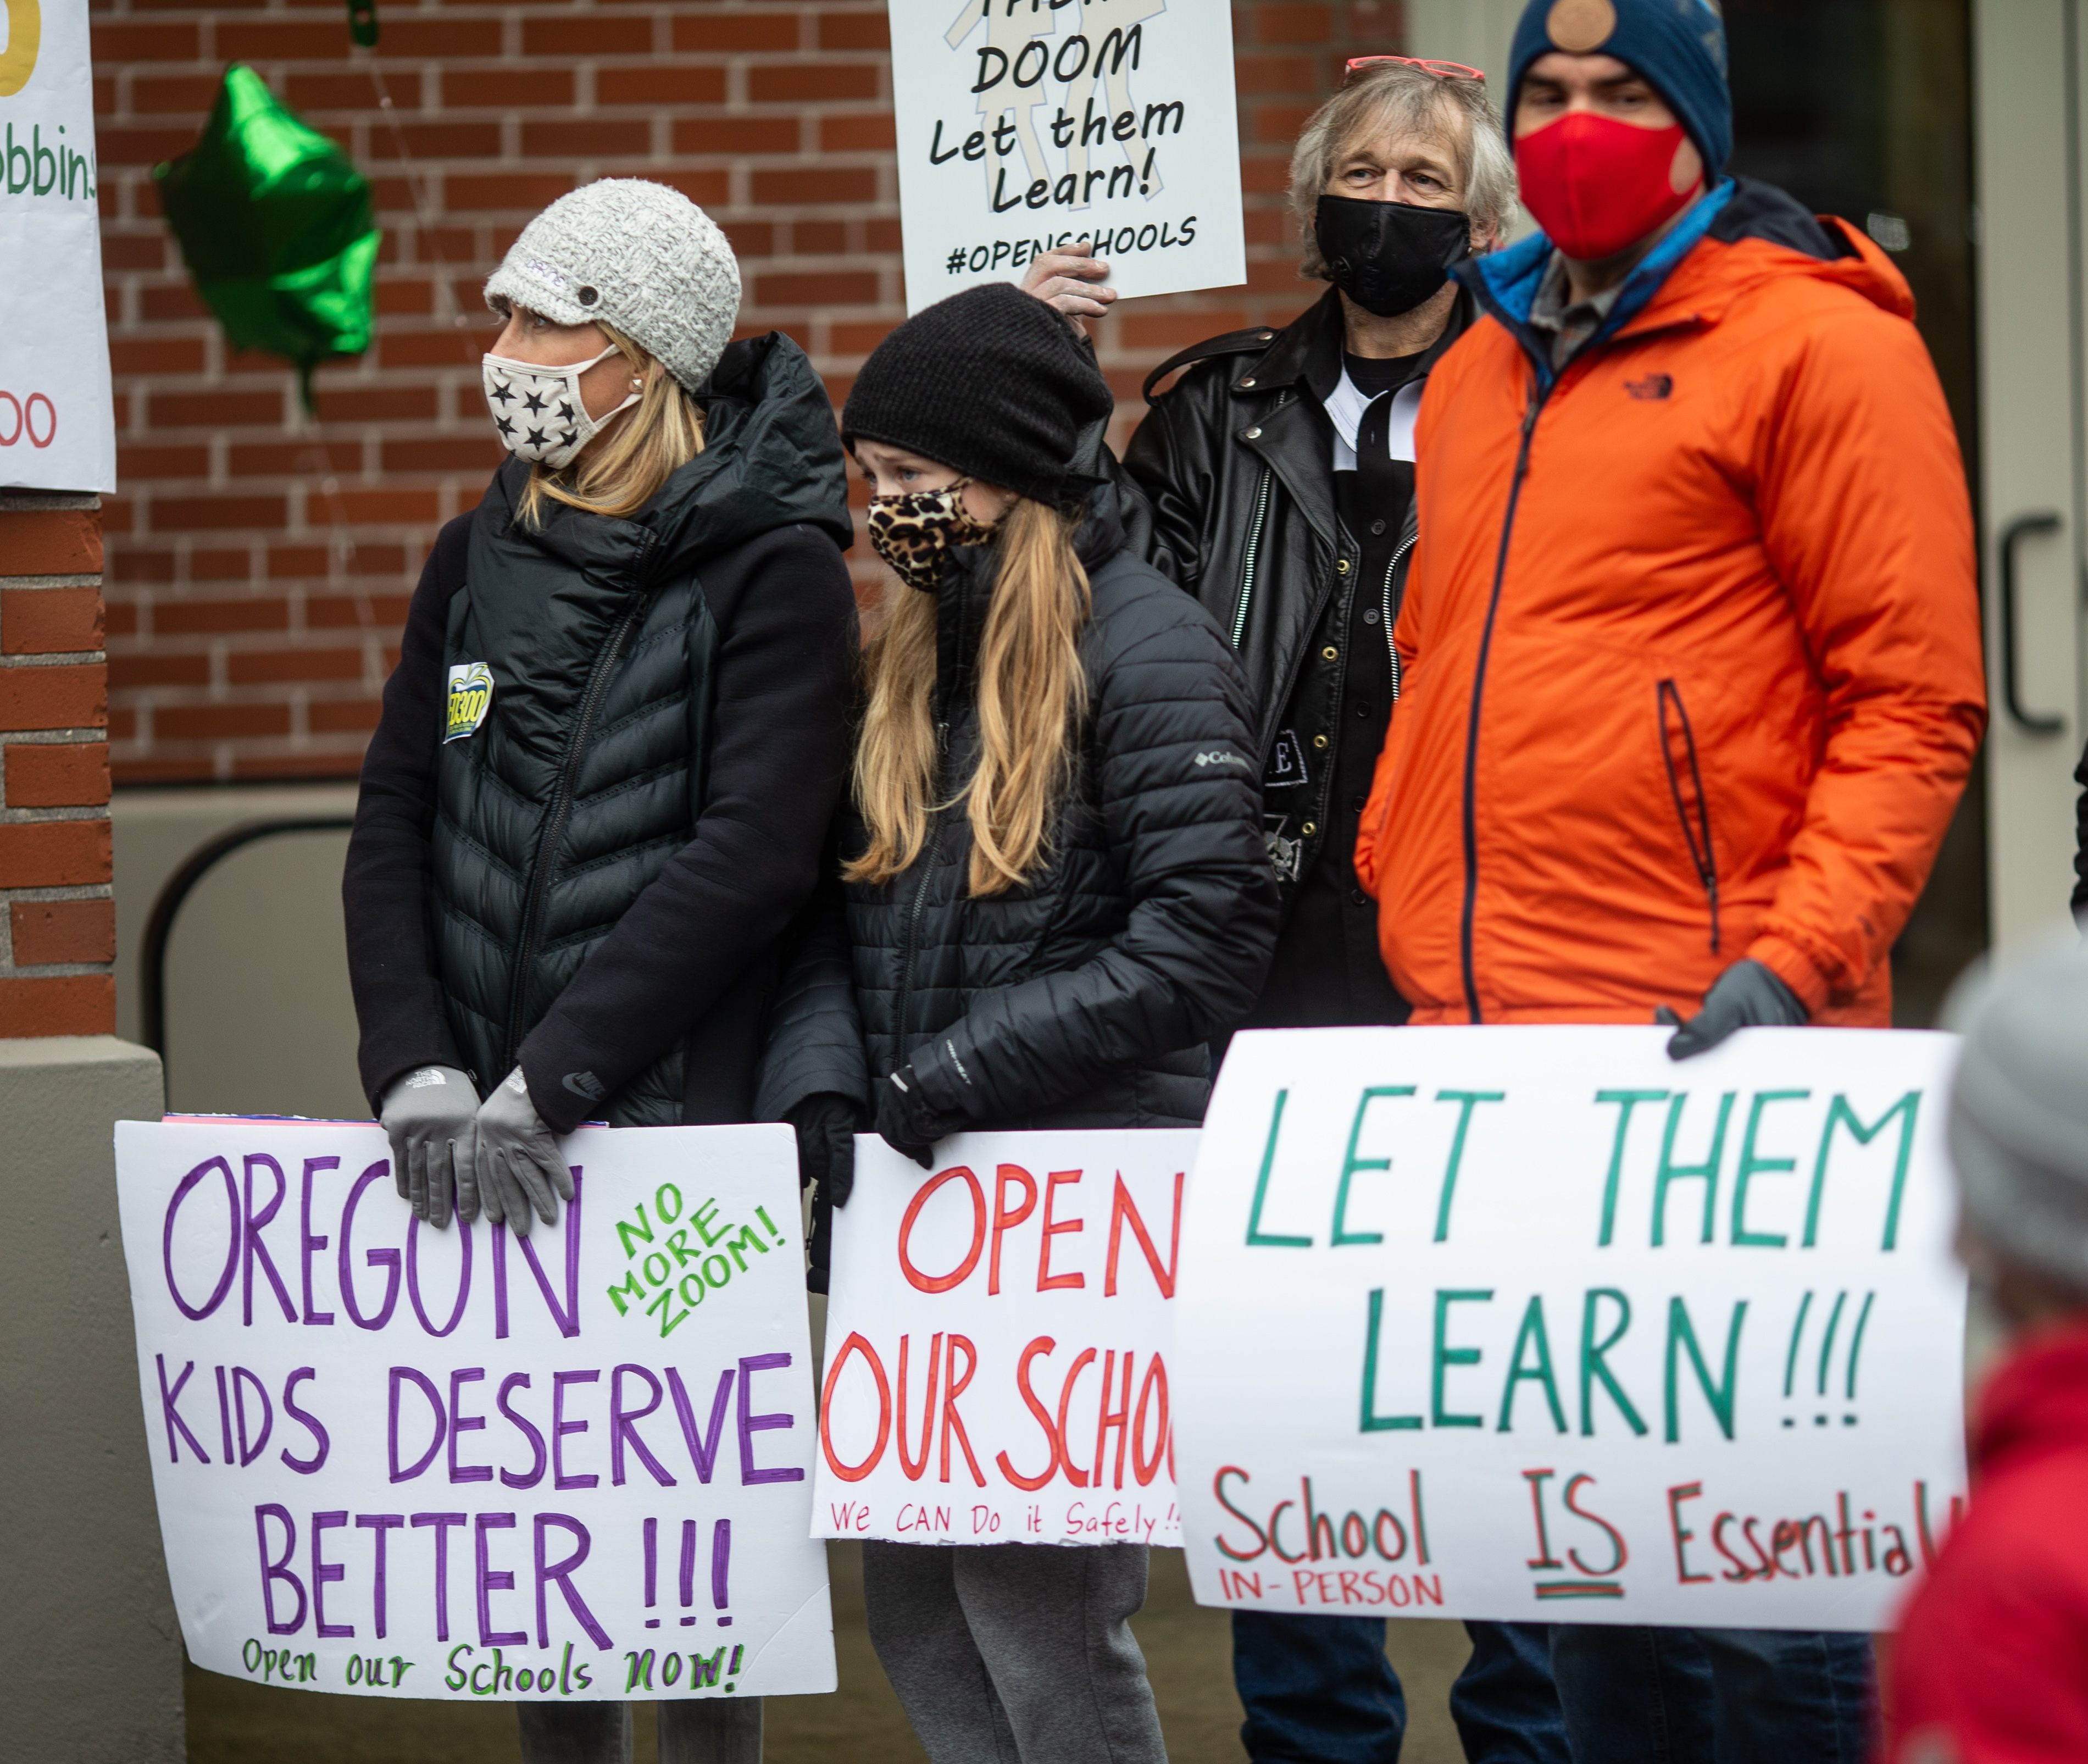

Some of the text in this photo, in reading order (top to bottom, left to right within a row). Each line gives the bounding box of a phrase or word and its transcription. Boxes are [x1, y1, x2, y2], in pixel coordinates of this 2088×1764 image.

[971, 24, 1142, 93] DOOM
[930, 97, 1184, 165] Let them
[993, 147, 1156, 213] Learn!
[616, 1183, 683, 1261] NO
[1246, 1086, 1922, 1251] LET THEM
[163, 1153, 583, 1339] OREGON
[606, 1197, 735, 1317] MORE
[645, 1205, 786, 1339] ZOOM!
[898, 1160, 1185, 1300] OPEN
[156, 1352, 804, 1490] KIDS DESERVE
[819, 1330, 1176, 1492] OUR SCHO
[831, 1501, 870, 1532] We
[896, 1504, 951, 1532] CAN
[971, 1505, 1001, 1534] Do
[1028, 1505, 1042, 1533] it
[1213, 1465, 1431, 1566] School
[1521, 1468, 1628, 1576] IS
[242, 1638, 317, 1683] Open
[345, 1654, 417, 1689] our
[445, 1641, 593, 1696] Schools
